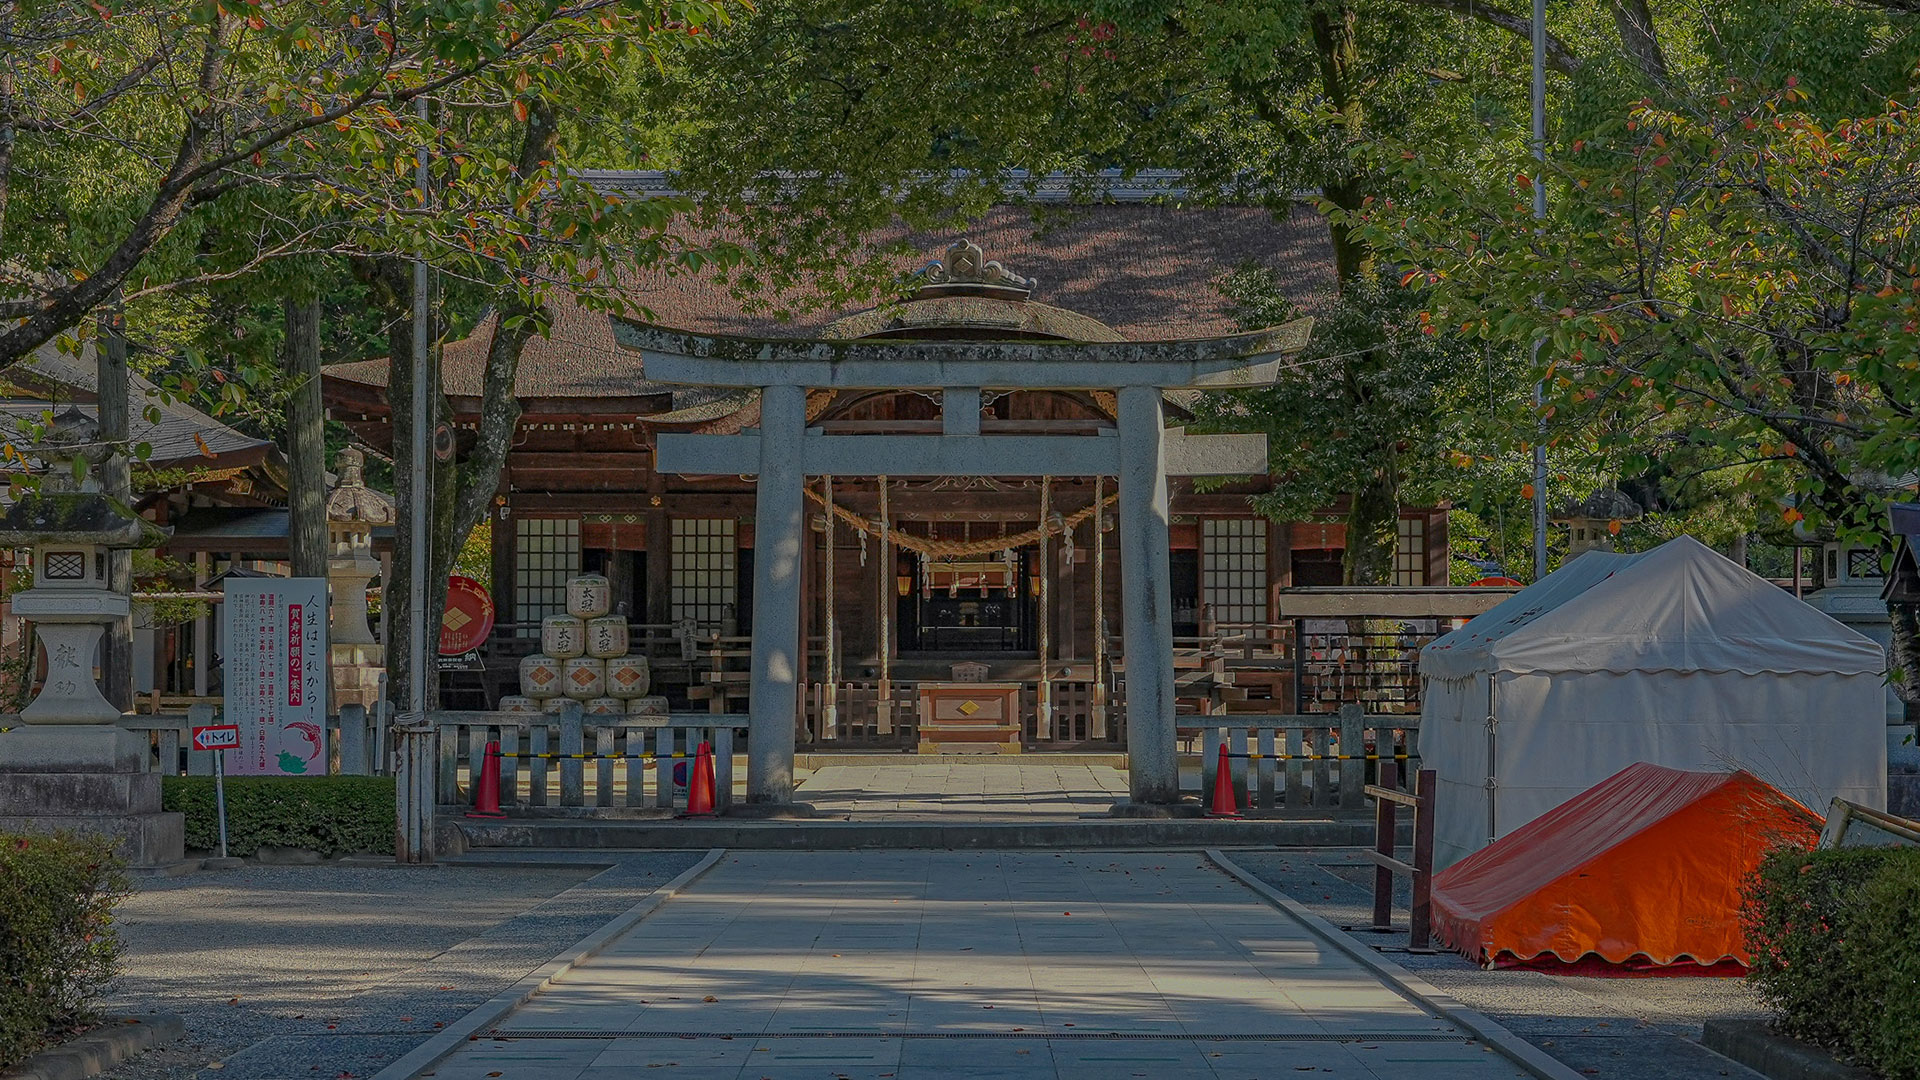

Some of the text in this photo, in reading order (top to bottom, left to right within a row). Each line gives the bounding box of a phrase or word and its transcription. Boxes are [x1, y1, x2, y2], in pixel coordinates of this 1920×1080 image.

[581, 587, 595, 612] 太冠
[558, 628, 571, 653] 太冠
[599, 626, 612, 652] 太冠
[289, 608, 301, 703] 賀寿祈願のご案内
[305, 594, 319, 719] 人生はこれから！
[212, 731, 235, 743] トイレ
